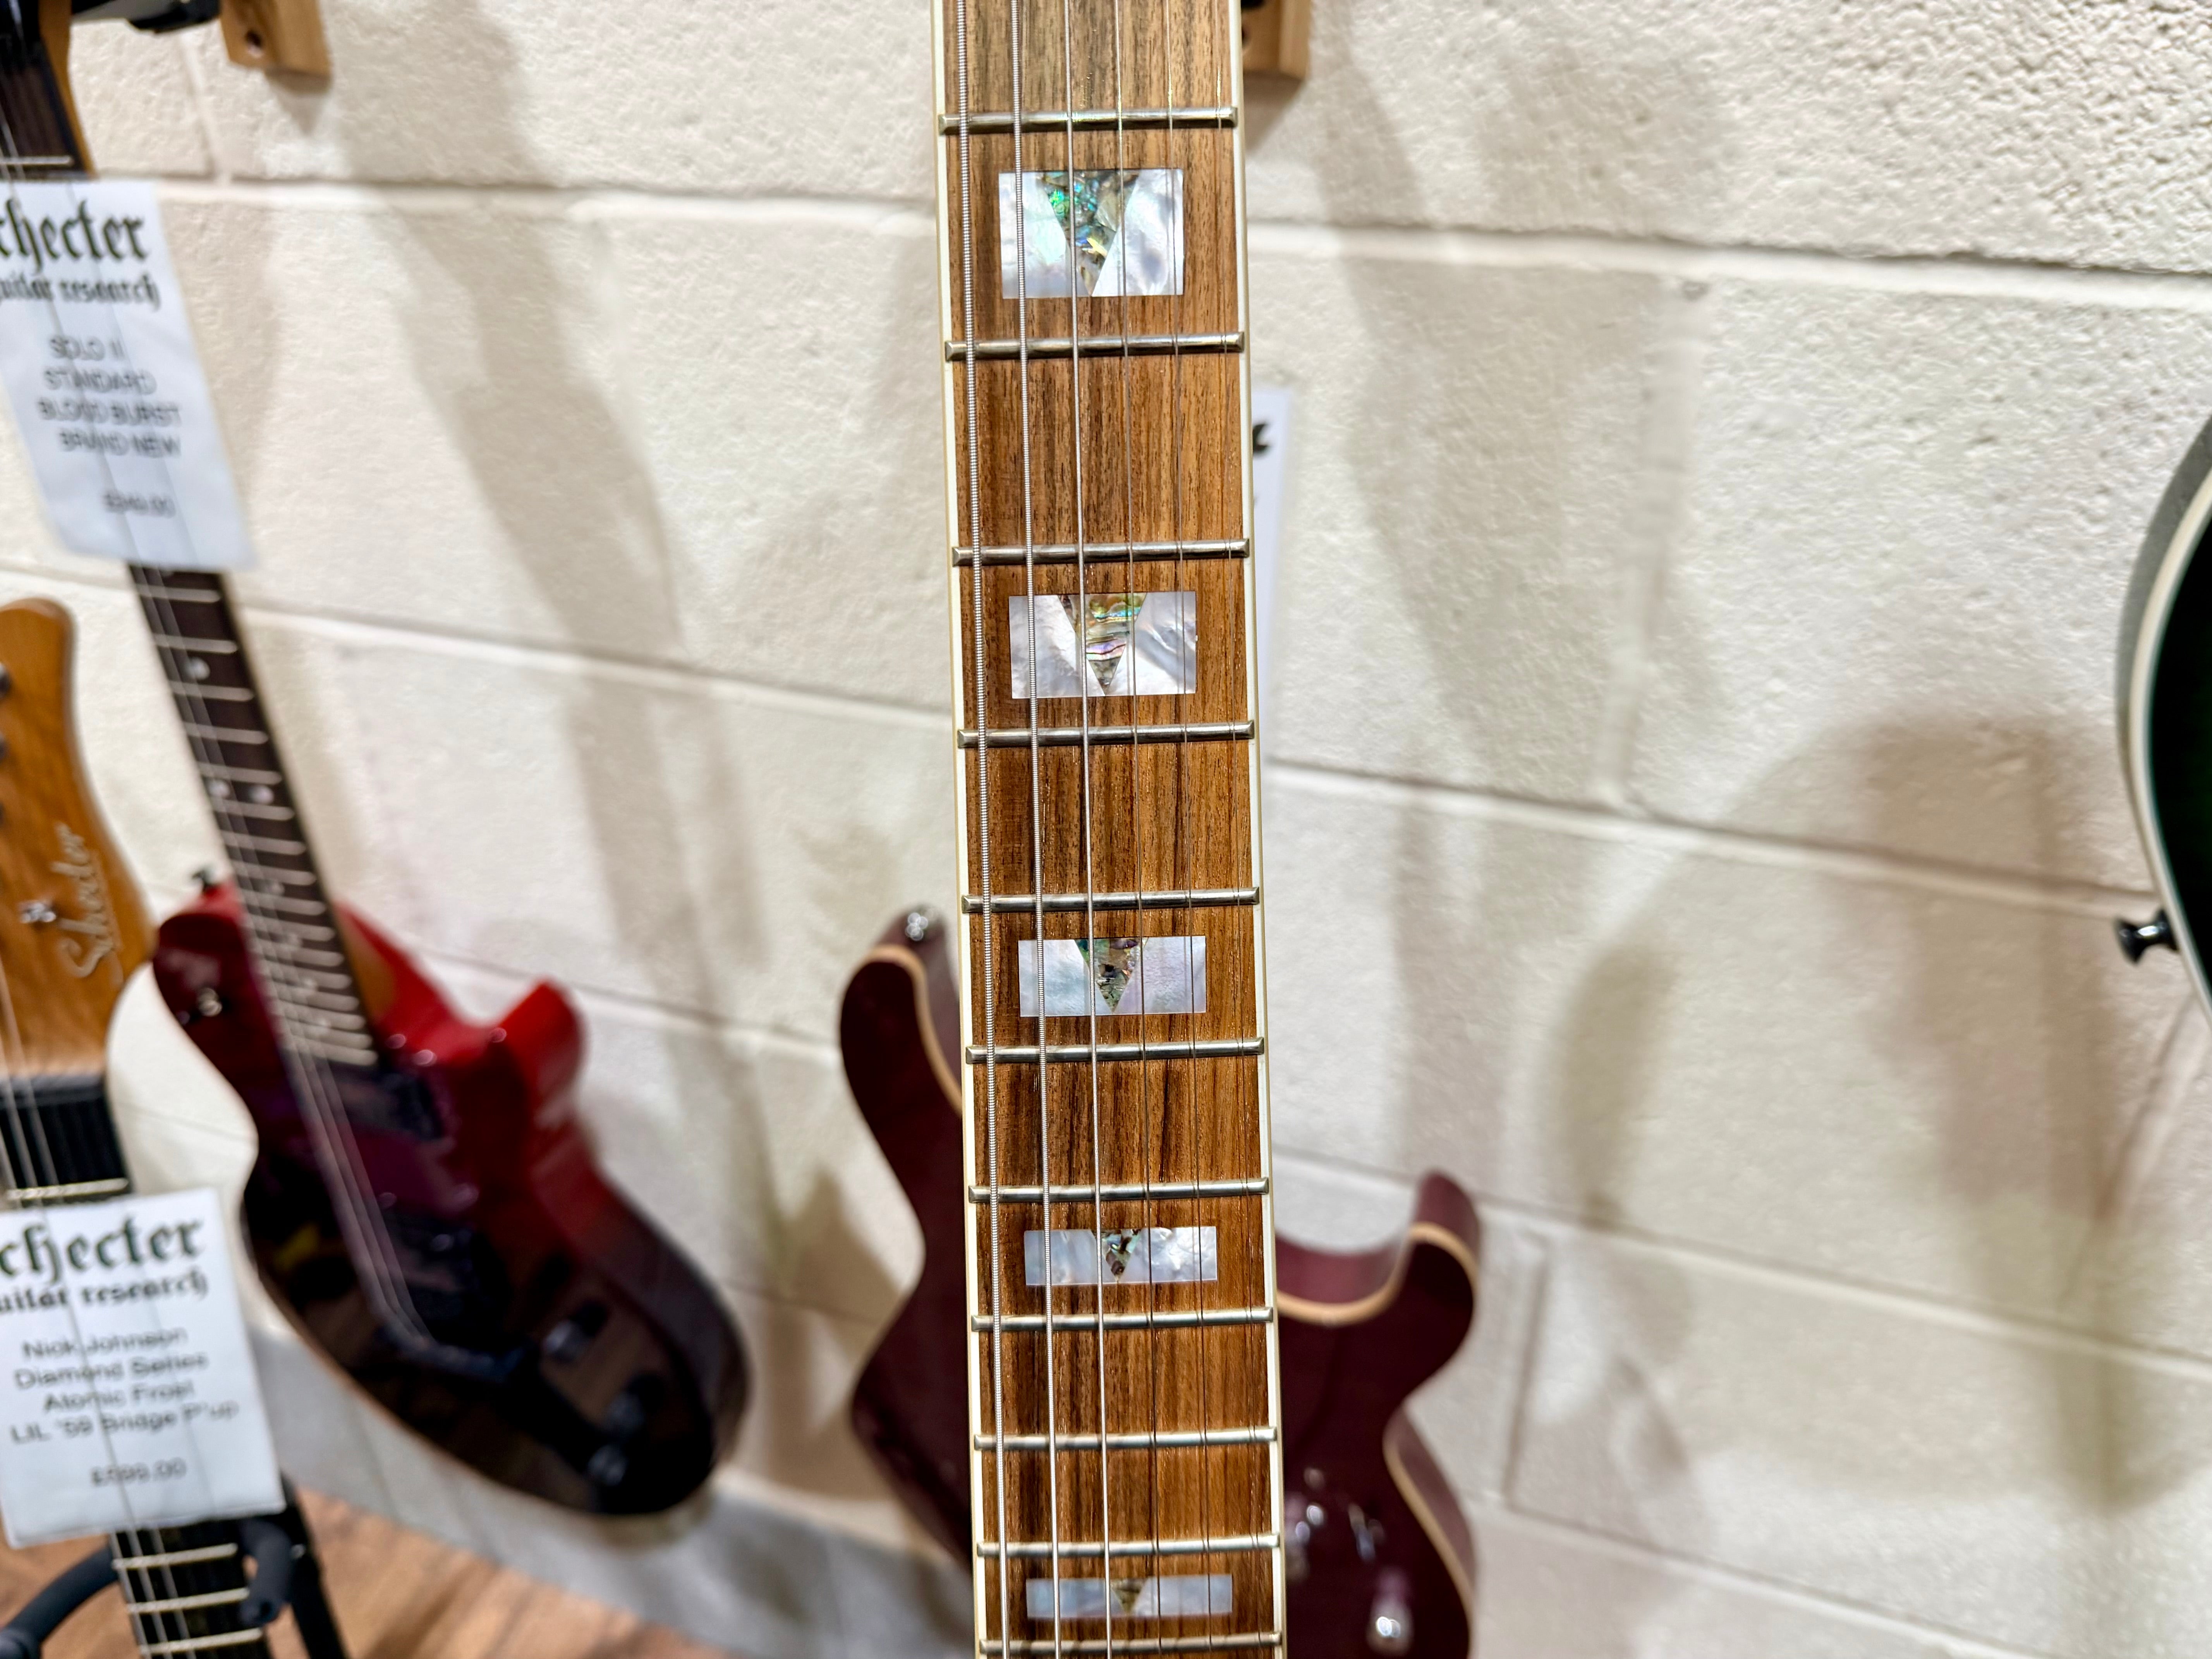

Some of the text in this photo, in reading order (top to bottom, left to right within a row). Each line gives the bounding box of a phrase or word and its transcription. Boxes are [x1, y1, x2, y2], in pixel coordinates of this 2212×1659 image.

[59, 273, 161, 312] research
[81, 1265, 209, 1305] research
[22, 1338, 76, 1358] Nick
[14, 1352, 208, 1389] Diamond Series
[44, 1380, 194, 1412] Atomic Frost
[101, 1412, 177, 1435] Bridge
